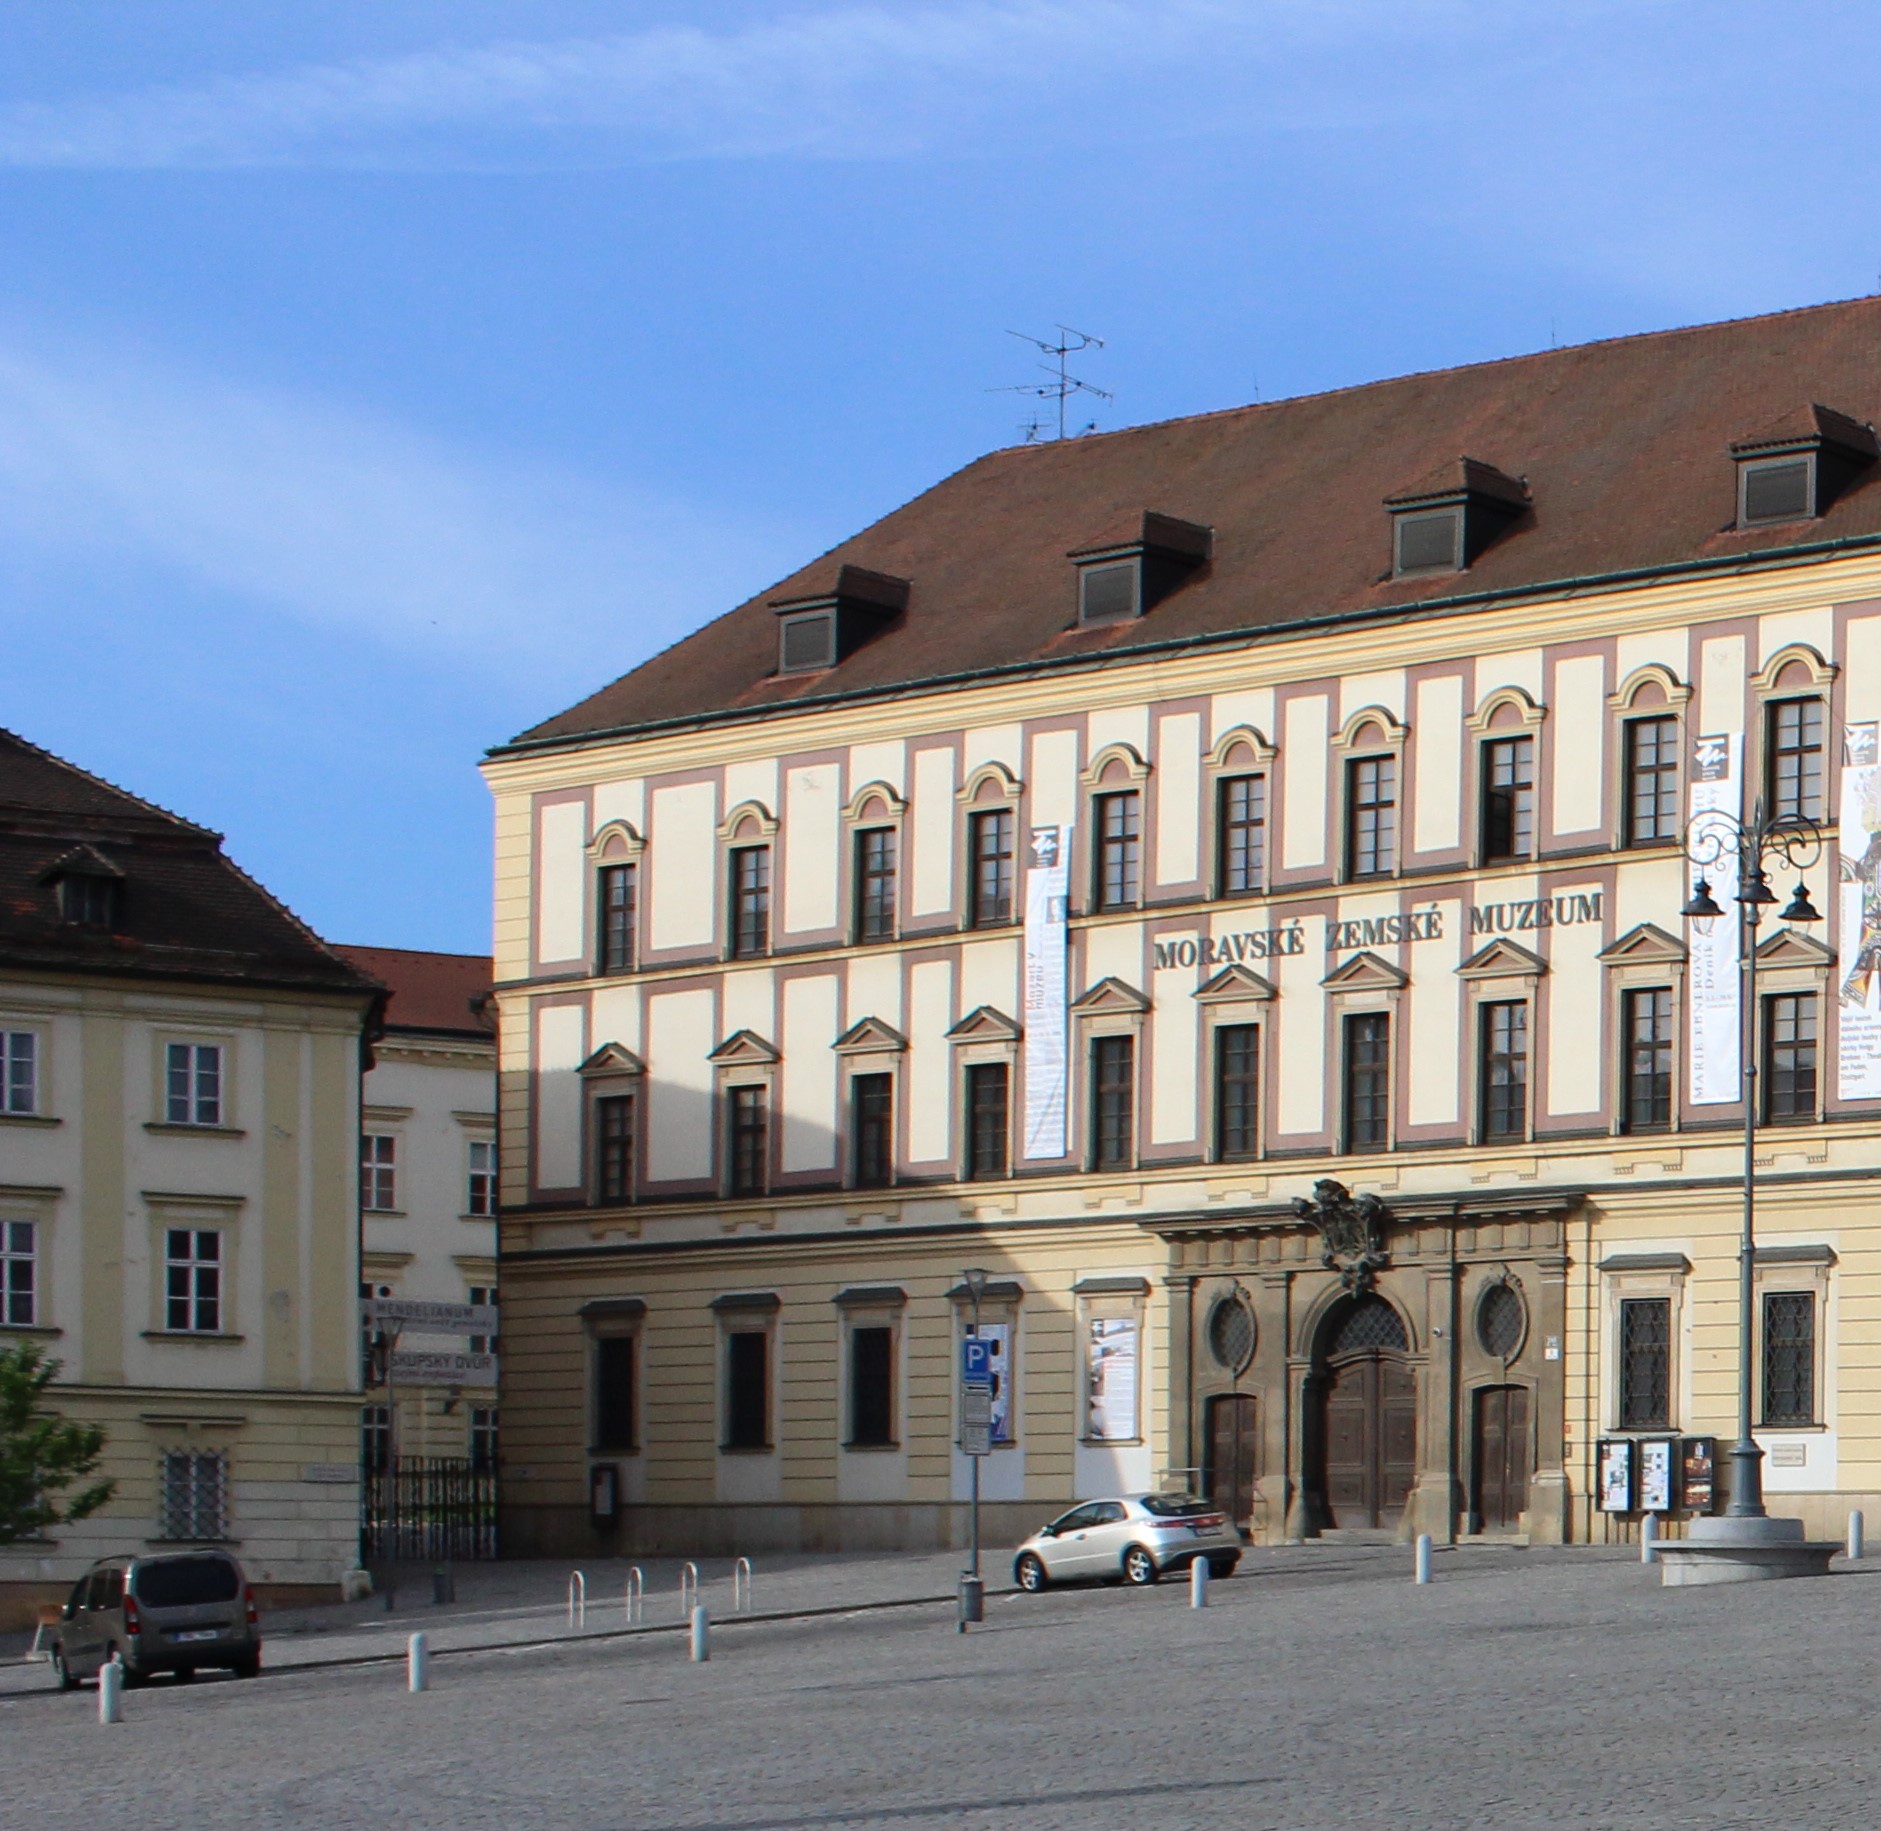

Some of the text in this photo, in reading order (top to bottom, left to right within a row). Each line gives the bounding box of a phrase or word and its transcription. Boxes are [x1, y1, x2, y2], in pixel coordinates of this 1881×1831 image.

[1153, 892, 1604, 971] MORAVSKÉ ZEMSKÉ MUZEUM
[1693, 1041, 1704, 1099] MARIE
[376, 1303, 474, 1318] MENDELIANUM
[968, 1345, 984, 1369] P
